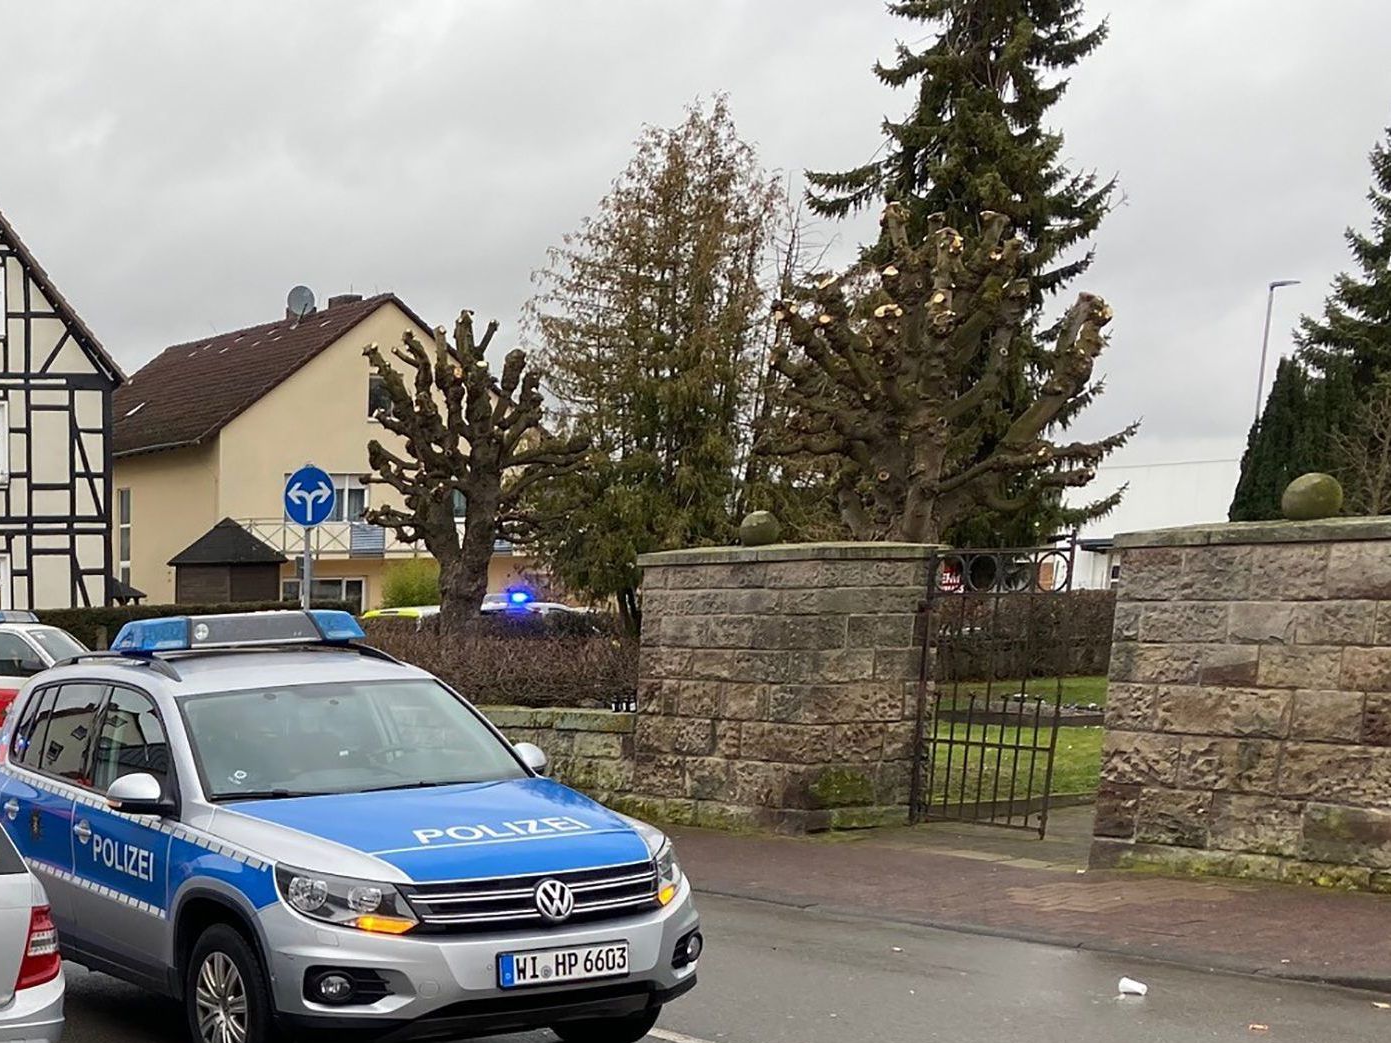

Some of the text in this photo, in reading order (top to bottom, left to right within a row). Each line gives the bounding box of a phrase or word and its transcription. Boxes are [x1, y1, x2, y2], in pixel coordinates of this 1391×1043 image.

[412, 815, 592, 845] POLIZEI
[92, 833, 155, 883] POLIZEI
[515, 957, 540, 981] WI
[555, 952, 579, 977] HP
[583, 946, 627, 974] 6603
